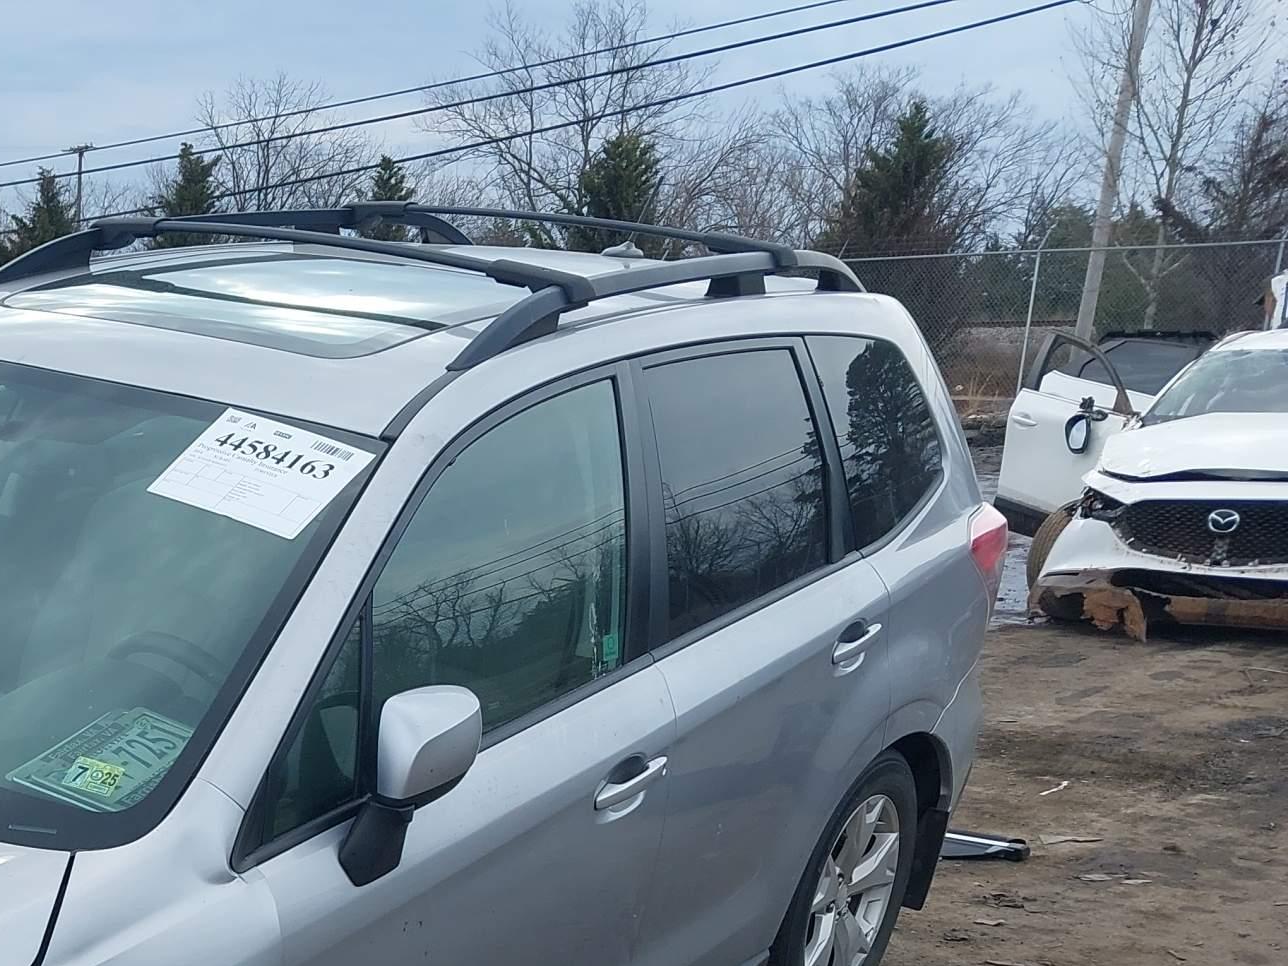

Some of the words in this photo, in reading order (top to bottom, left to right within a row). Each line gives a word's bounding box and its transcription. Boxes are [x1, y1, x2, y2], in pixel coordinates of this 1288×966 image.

[215, 432, 335, 480] 44584163
[72, 765, 89, 782] 7
[101, 771, 120, 787] 25
